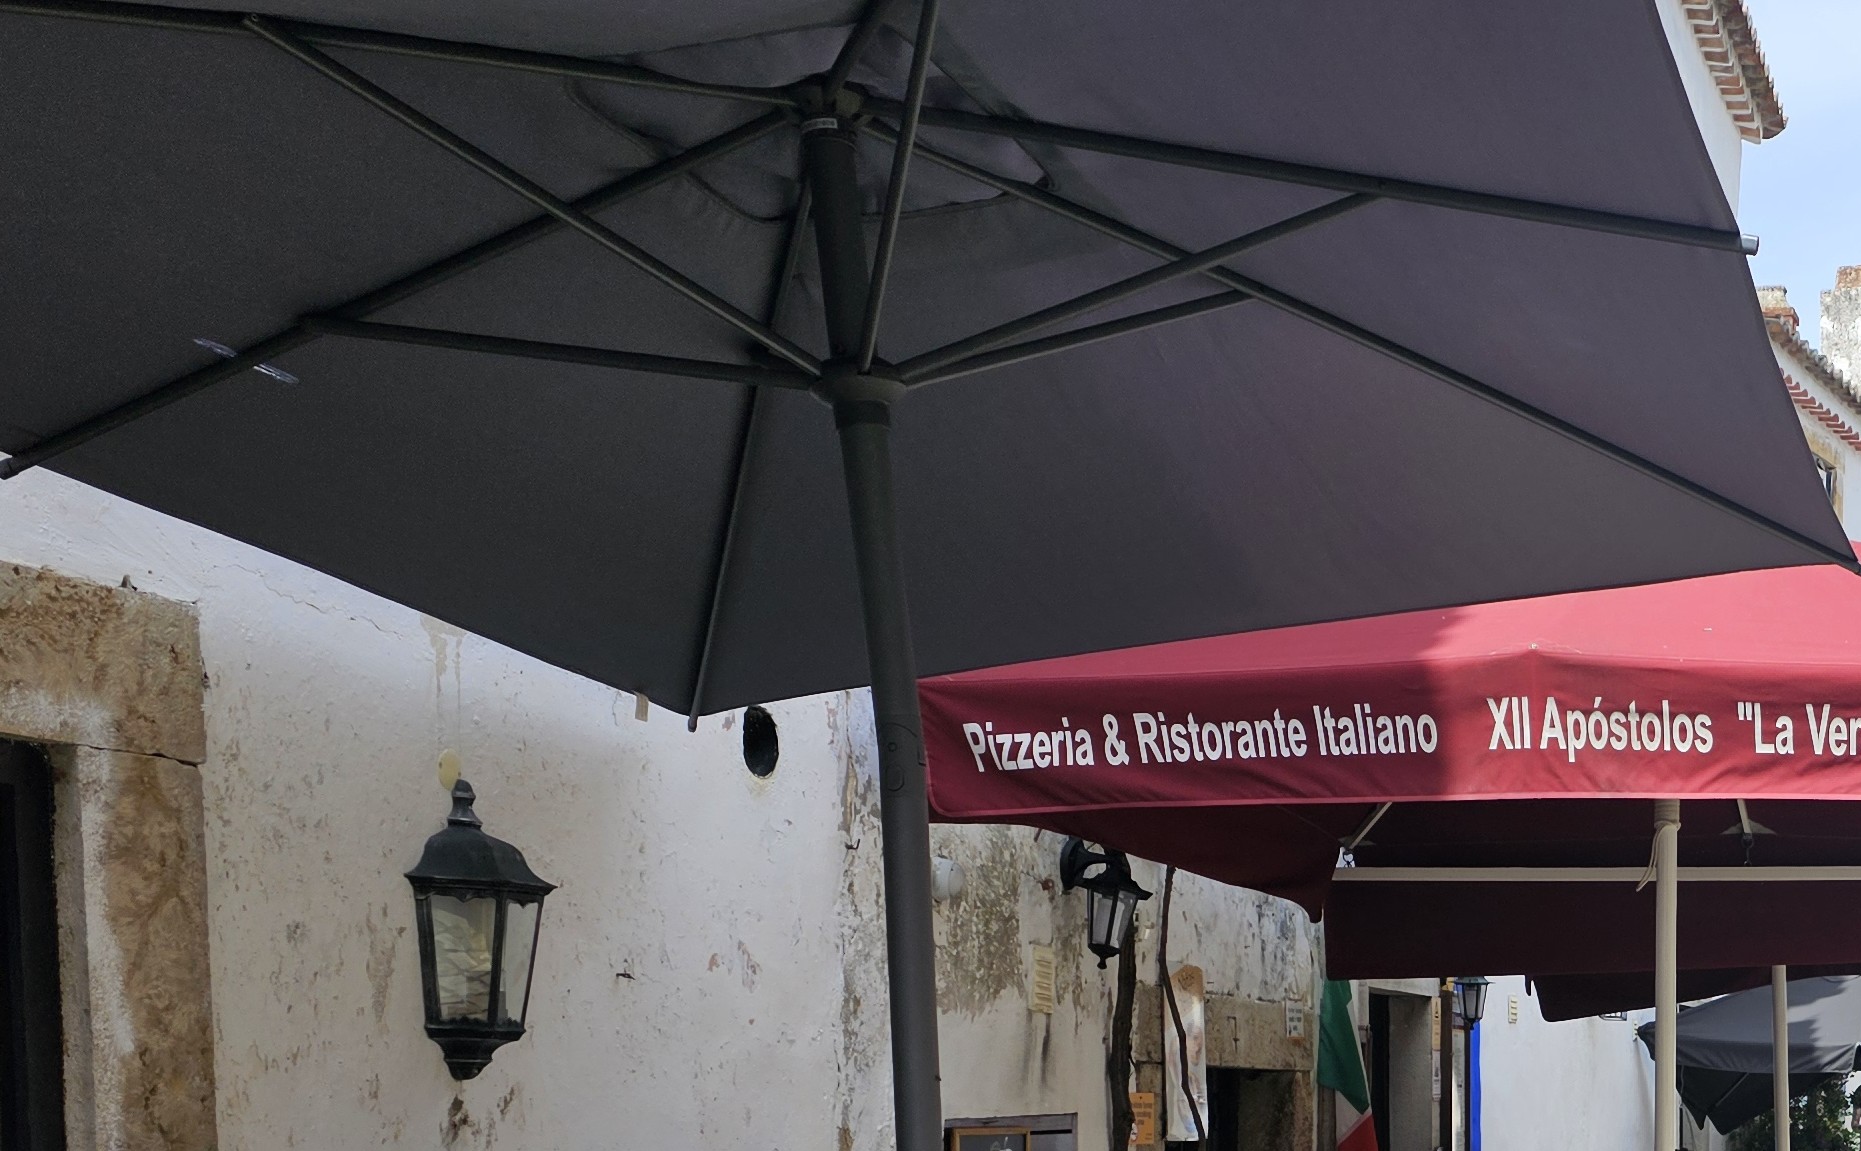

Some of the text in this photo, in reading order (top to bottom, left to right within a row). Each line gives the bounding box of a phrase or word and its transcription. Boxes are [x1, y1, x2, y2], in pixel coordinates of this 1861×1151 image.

[963, 716, 1095, 773] Pizzeria
[1103, 713, 1130, 766] &
[1132, 708, 1308, 764] Ristorante
[1312, 703, 1438, 756] Italiano
[1486, 696, 1532, 751] XII
[1539, 696, 1714, 763] Apóstolos
[1737, 701, 1795, 756] "La
